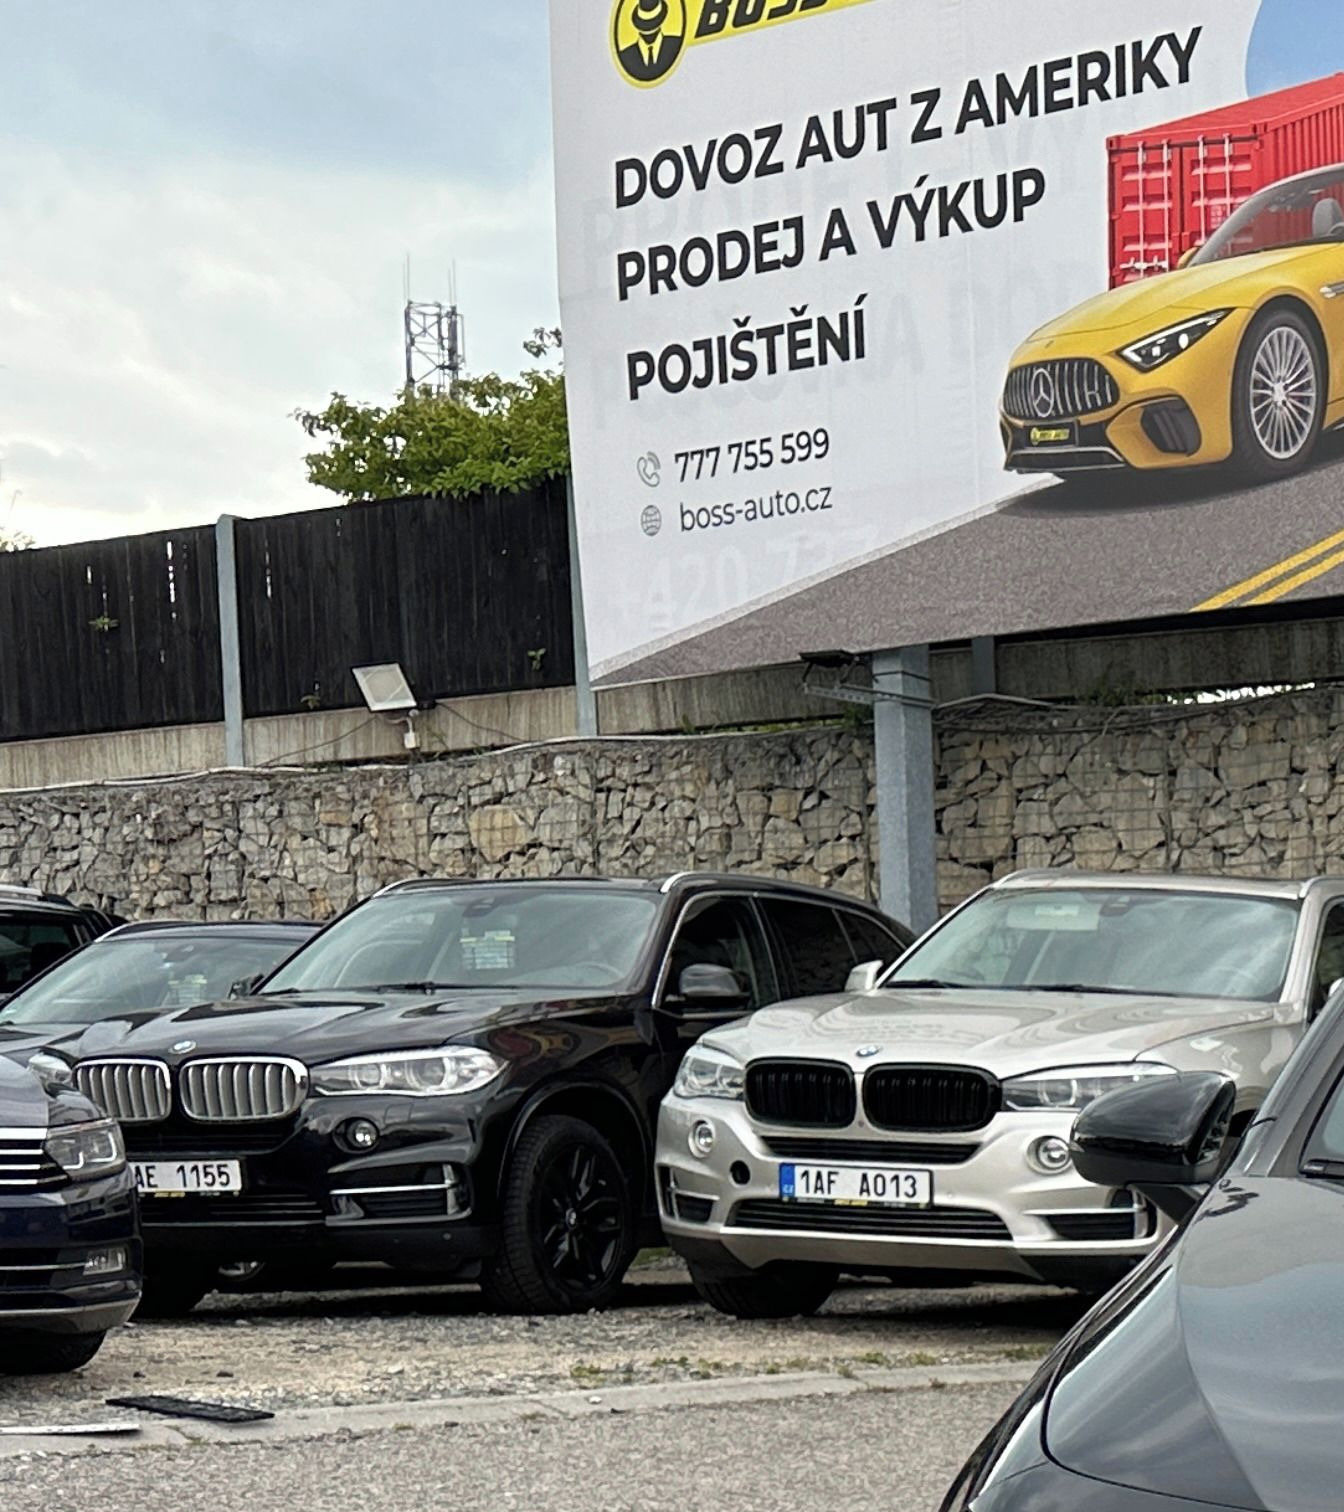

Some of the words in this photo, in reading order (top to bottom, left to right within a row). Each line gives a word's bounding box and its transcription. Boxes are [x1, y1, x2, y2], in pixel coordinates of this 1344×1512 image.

[614, 123, 785, 209] DOVOZ
[795, 97, 898, 170] AUT
[910, 87, 943, 144] Z
[954, 25, 1203, 135] AMERIKY
[617, 215, 805, 302] PRODEJ
[818, 207, 857, 262] A
[866, 166, 1046, 249] VÝKUP
[626, 292, 868, 401] POJIŠTĚNÍ
[673, 446, 721, 483] 777
[727, 436, 774, 474] 755
[780, 427, 830, 464] 599
[679, 486, 833, 532] boss-auto.cz
[176, 1164, 231, 1188] 1155
[801, 1169, 840, 1195] 1AF
